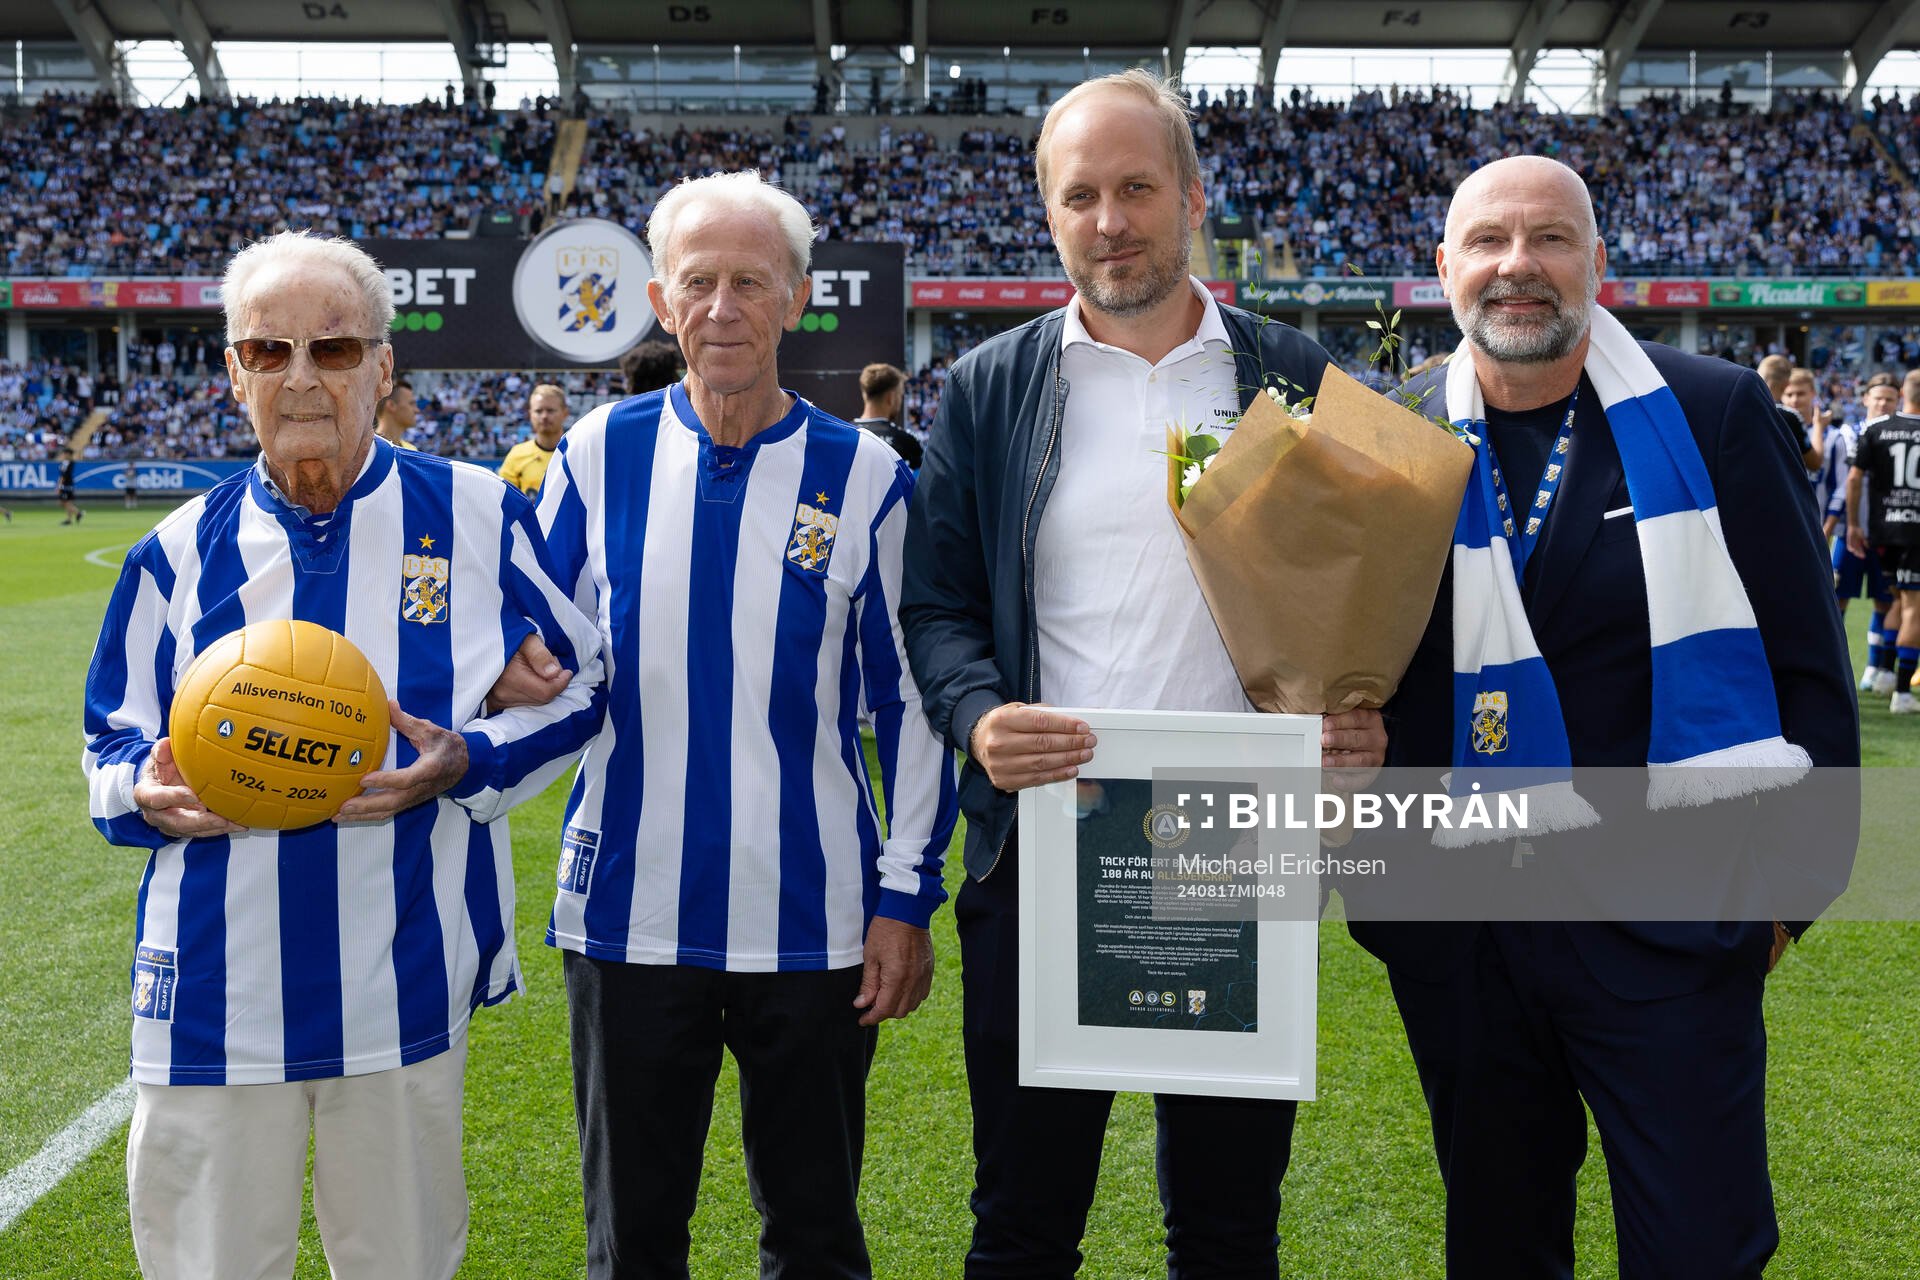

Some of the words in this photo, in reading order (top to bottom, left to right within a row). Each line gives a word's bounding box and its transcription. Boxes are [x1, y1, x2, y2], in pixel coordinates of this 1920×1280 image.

[669, 6, 712, 22] D5
[1031, 9, 1068, 24] F5
[0, 464, 56, 488] ITAL
[231, 682, 325, 710] Allsvenskan
[329, 699, 353, 719] 100
[355, 708, 367, 725] år
[244, 726, 342, 768] SELECT
[230, 769, 266, 793] 1924
[286, 786, 328, 801] 2024
[1099, 856, 1125, 866] TACK
[1128, 855, 1148, 867] FÖR
[1151, 858, 1170, 868] ERT
[1102, 869, 1122, 879] 100
[1124, 868, 1138, 879] ÅR
